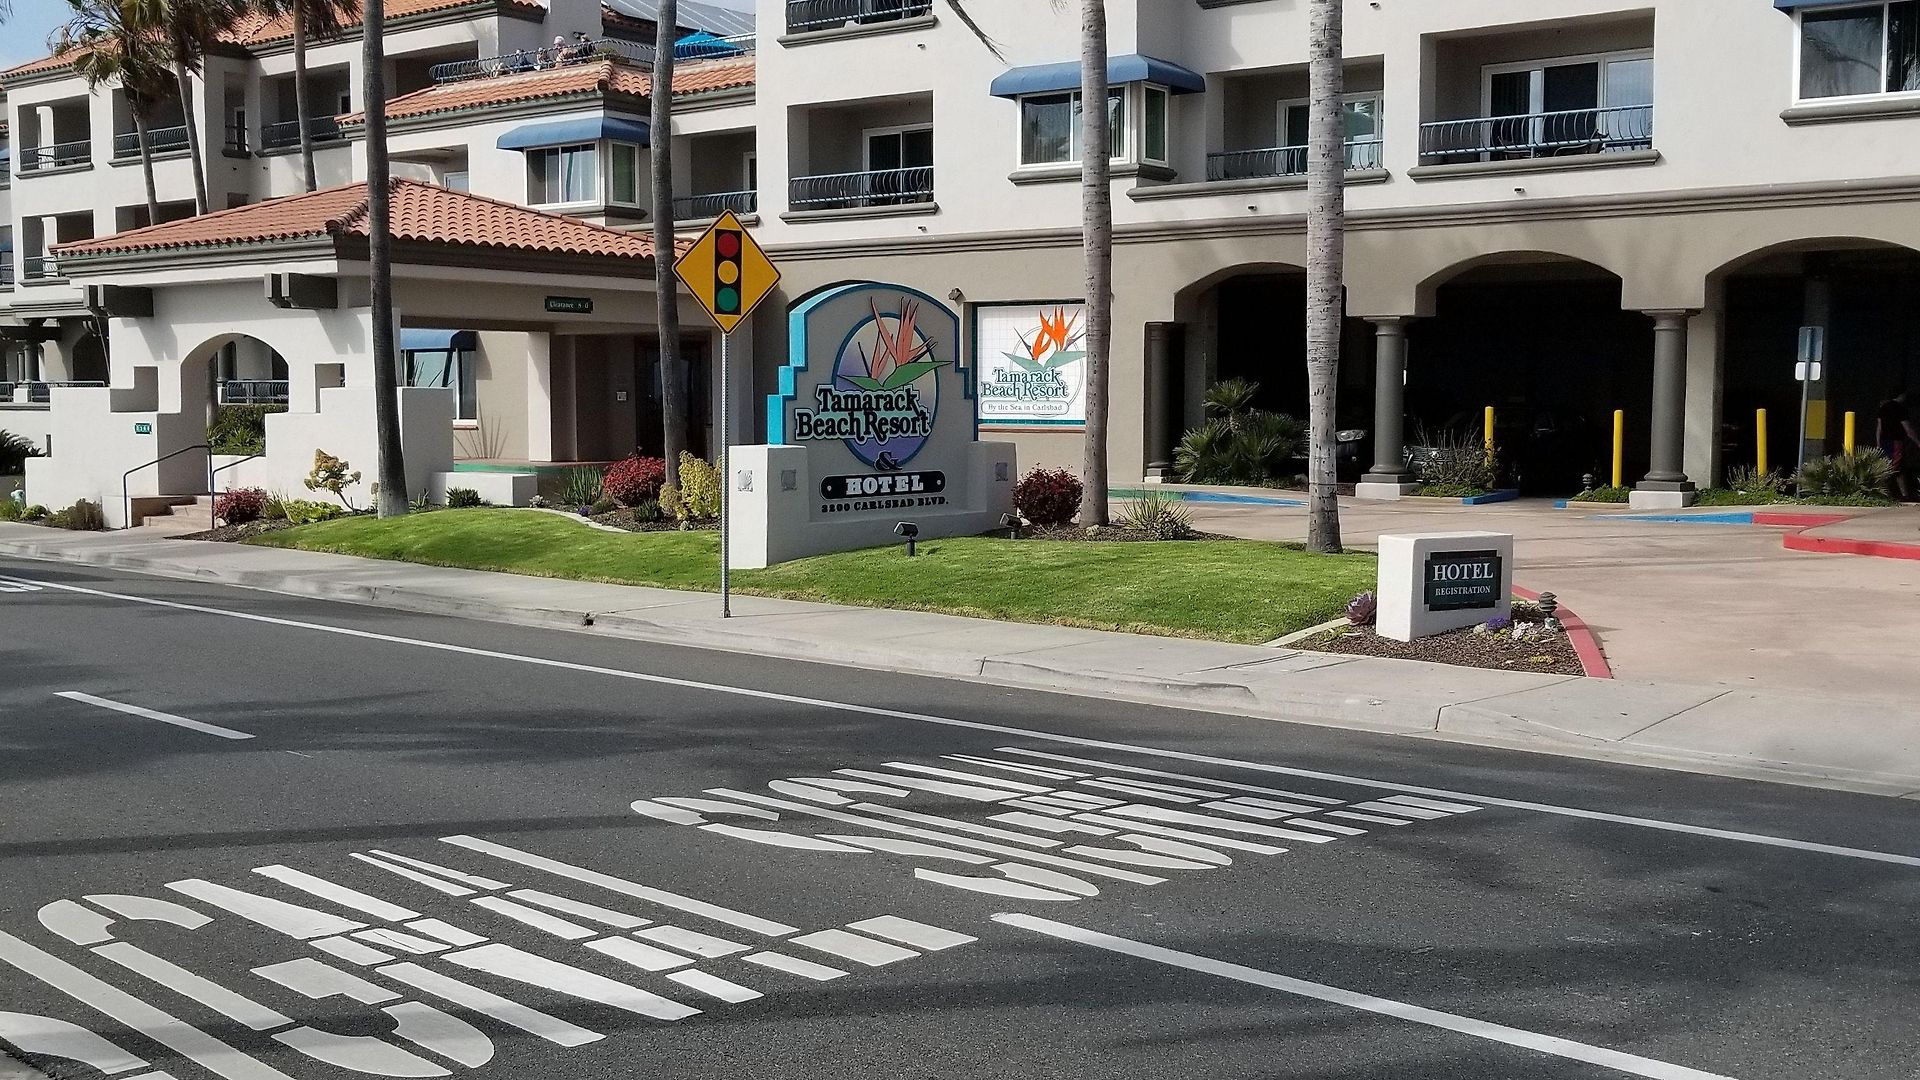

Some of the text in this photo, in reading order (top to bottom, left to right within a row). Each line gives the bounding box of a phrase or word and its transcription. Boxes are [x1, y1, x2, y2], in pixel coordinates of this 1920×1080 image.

[993, 366, 1063, 387] Tamarack
[818, 384, 920, 417] Tamarack
[982, 381, 1068, 400] Beach Resort
[796, 407, 929, 442] Beach Resort
[875, 451, 902, 471] &
[845, 475, 924, 495] HOTEL
[854, 499, 914, 511] CARLSBAD
[917, 496, 949, 506] BLVD.
[1433, 563, 1493, 580] HOTEL
[1435, 585, 1491, 596] REGISTRATION
